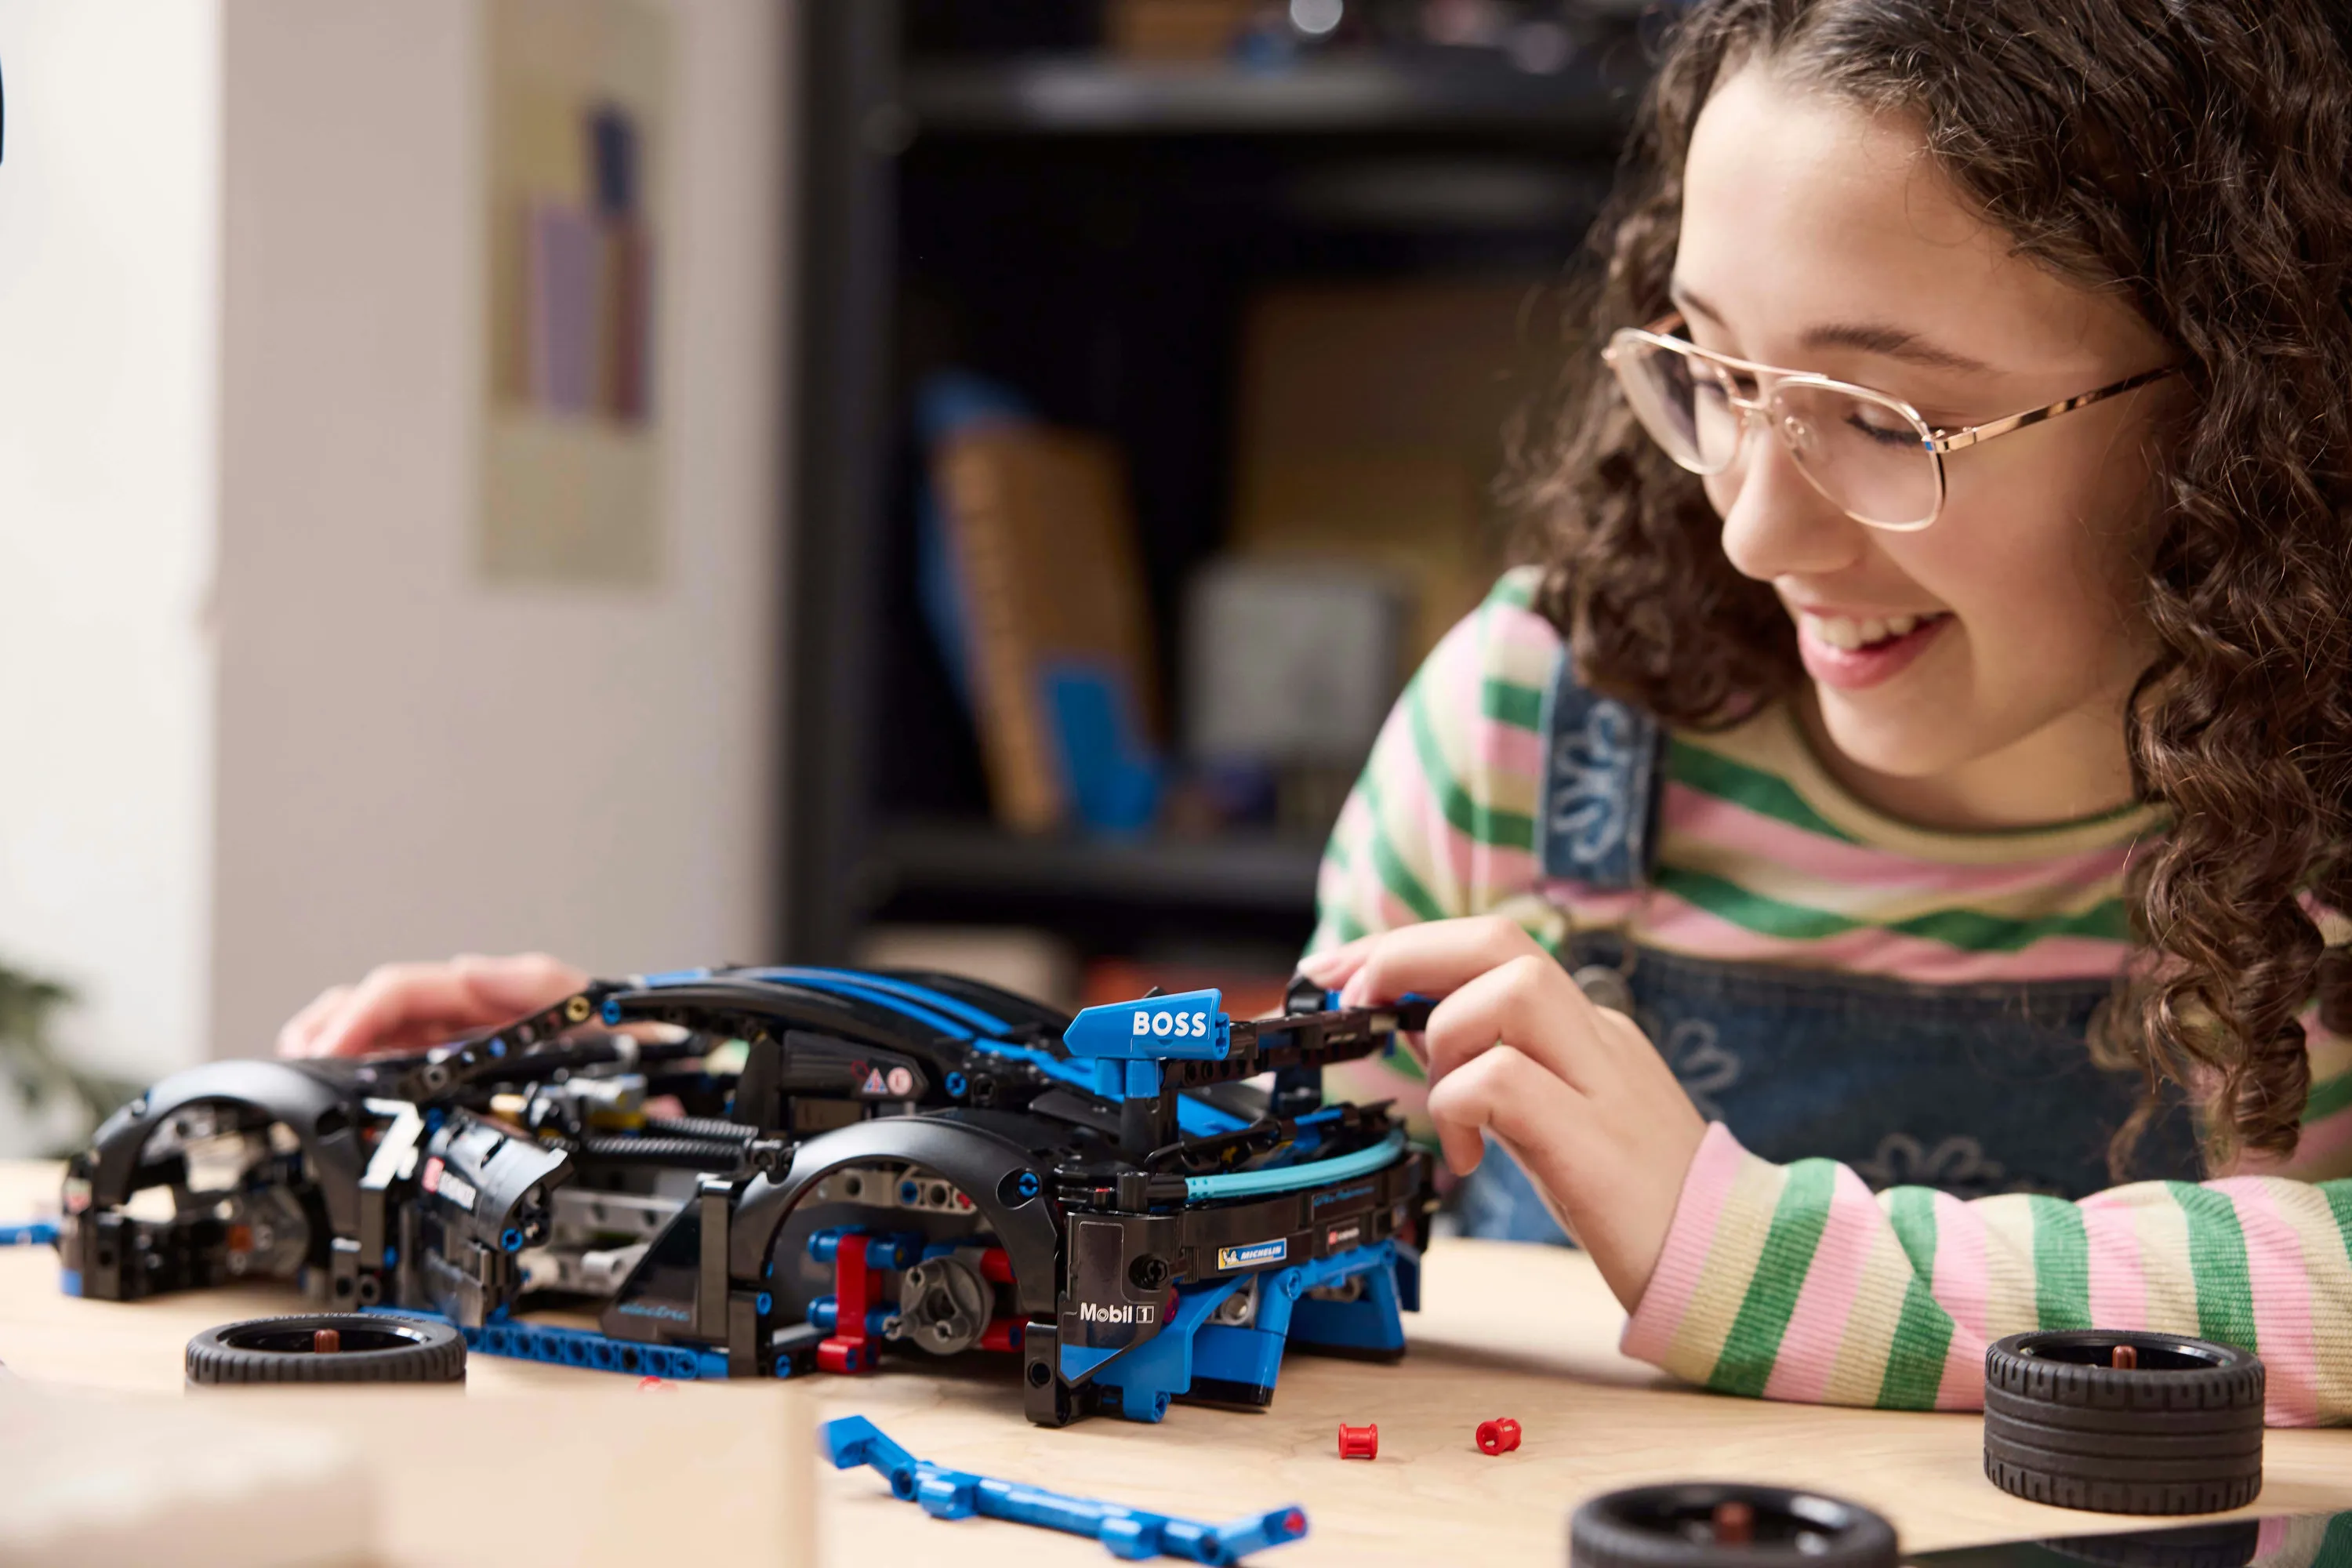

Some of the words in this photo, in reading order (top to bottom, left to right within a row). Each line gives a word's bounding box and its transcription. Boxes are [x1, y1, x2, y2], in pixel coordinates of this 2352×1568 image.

[1133, 1011, 1207, 1037] BOSS
[1240, 1245, 1282, 1260] MICHELIN
[1080, 1302, 1133, 1323] Mobil
